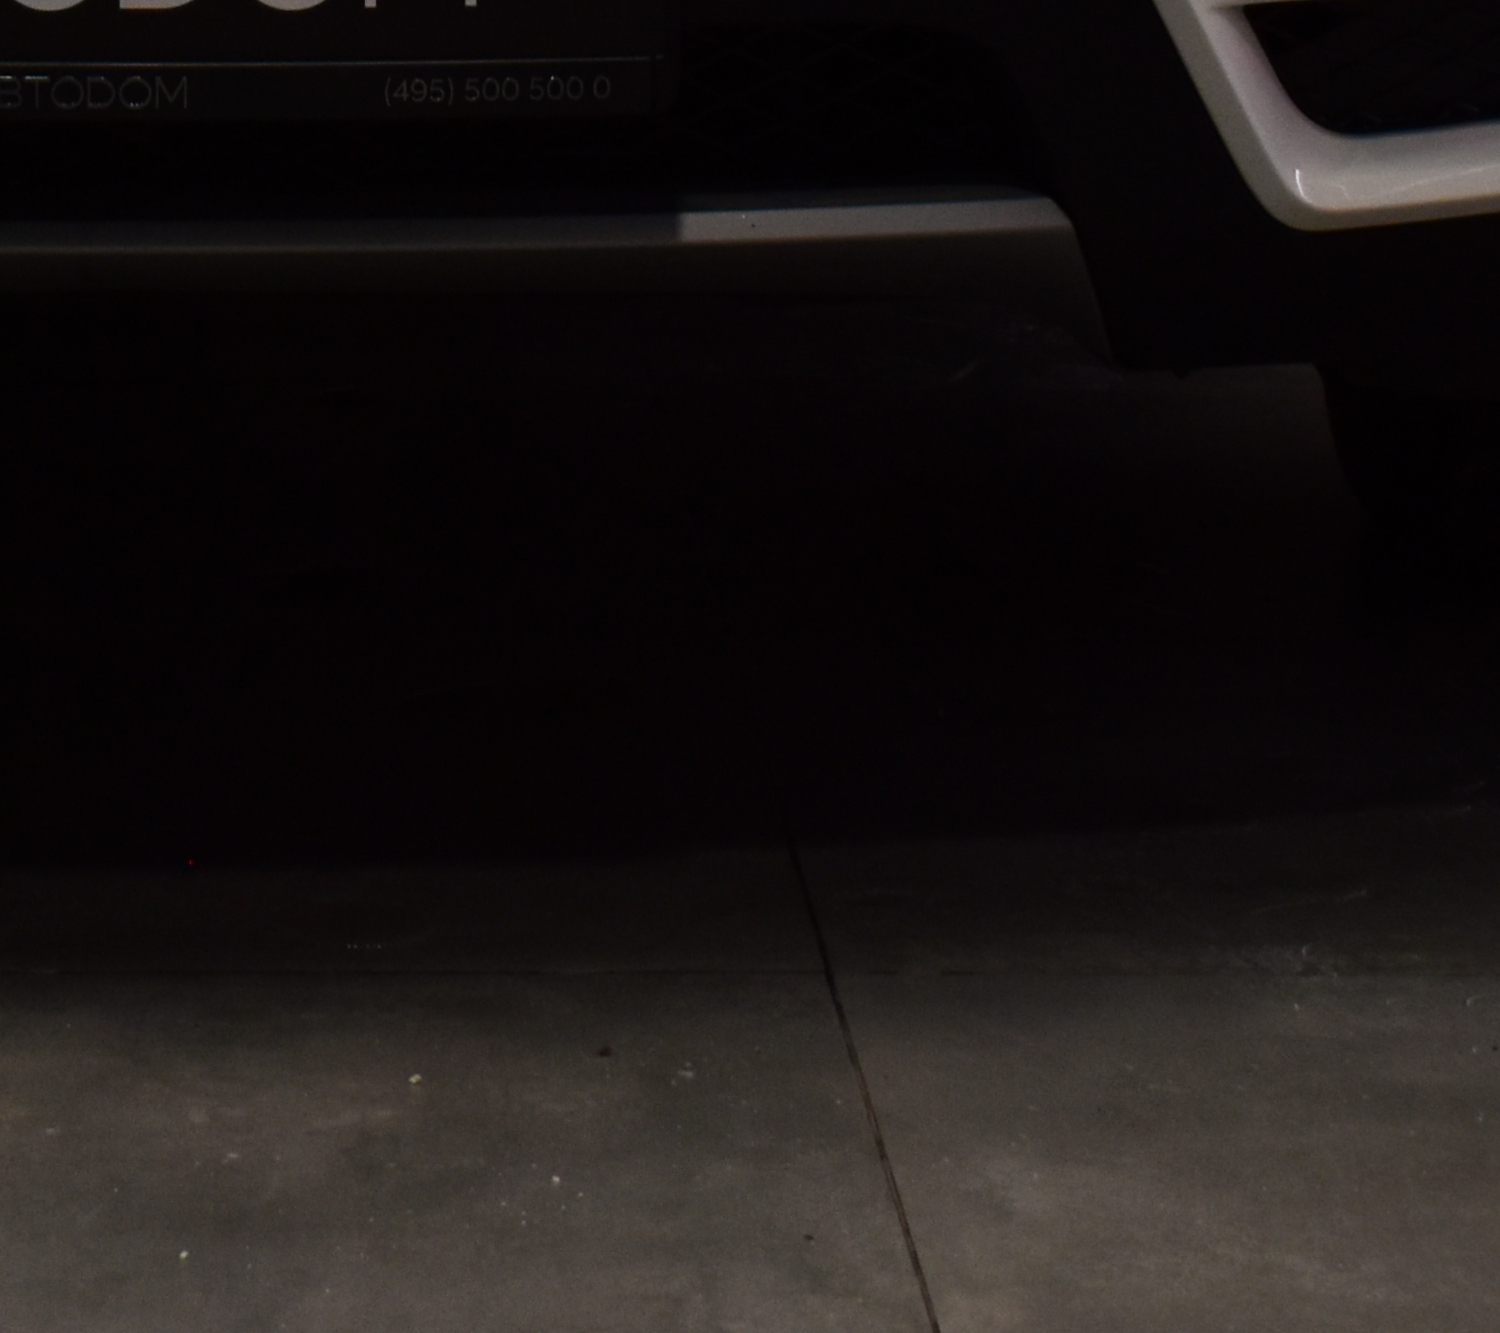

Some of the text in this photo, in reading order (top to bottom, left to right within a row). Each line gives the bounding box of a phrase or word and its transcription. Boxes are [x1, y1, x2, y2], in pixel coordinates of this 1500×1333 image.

[384, 74, 612, 107] (495) 500 500 0
